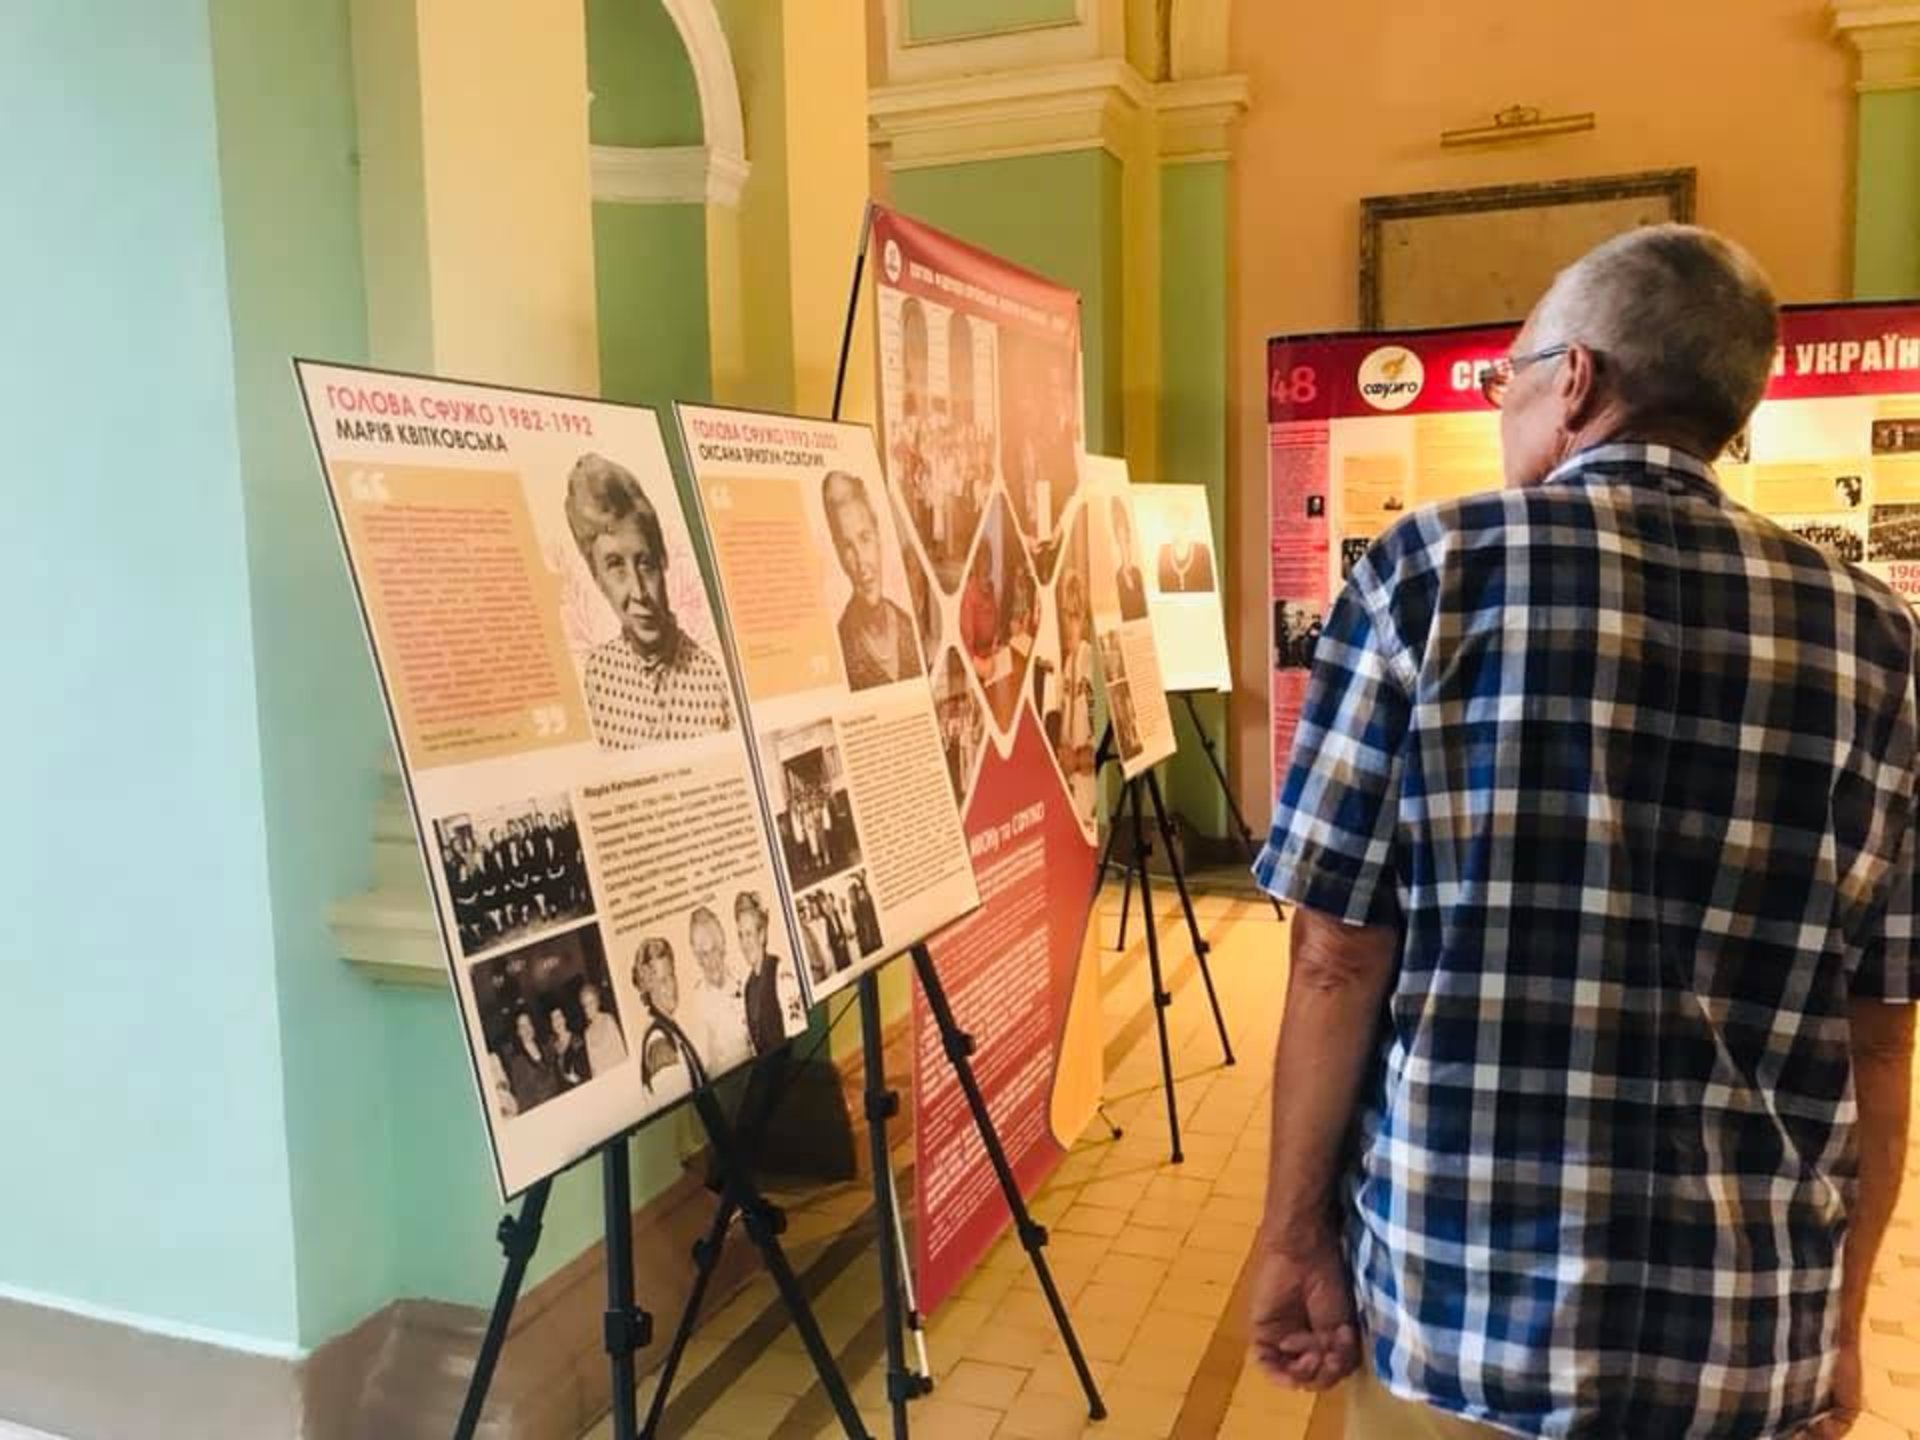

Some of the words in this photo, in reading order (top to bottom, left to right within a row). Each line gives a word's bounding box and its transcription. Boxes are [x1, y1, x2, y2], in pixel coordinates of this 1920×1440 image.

[1795, 333, 1920, 376] УКРАЇН
[1271, 365, 1317, 404] 48
[326, 385, 416, 417] ГОЛОВА
[420, 397, 494, 426] СФУЖО
[499, 406, 593, 436] 1982-1992
[693, 419, 740, 440] ГОЛОВА
[336, 419, 394, 443] МАРІЯ
[399, 424, 508, 452] КВІТКОВСЬКА
